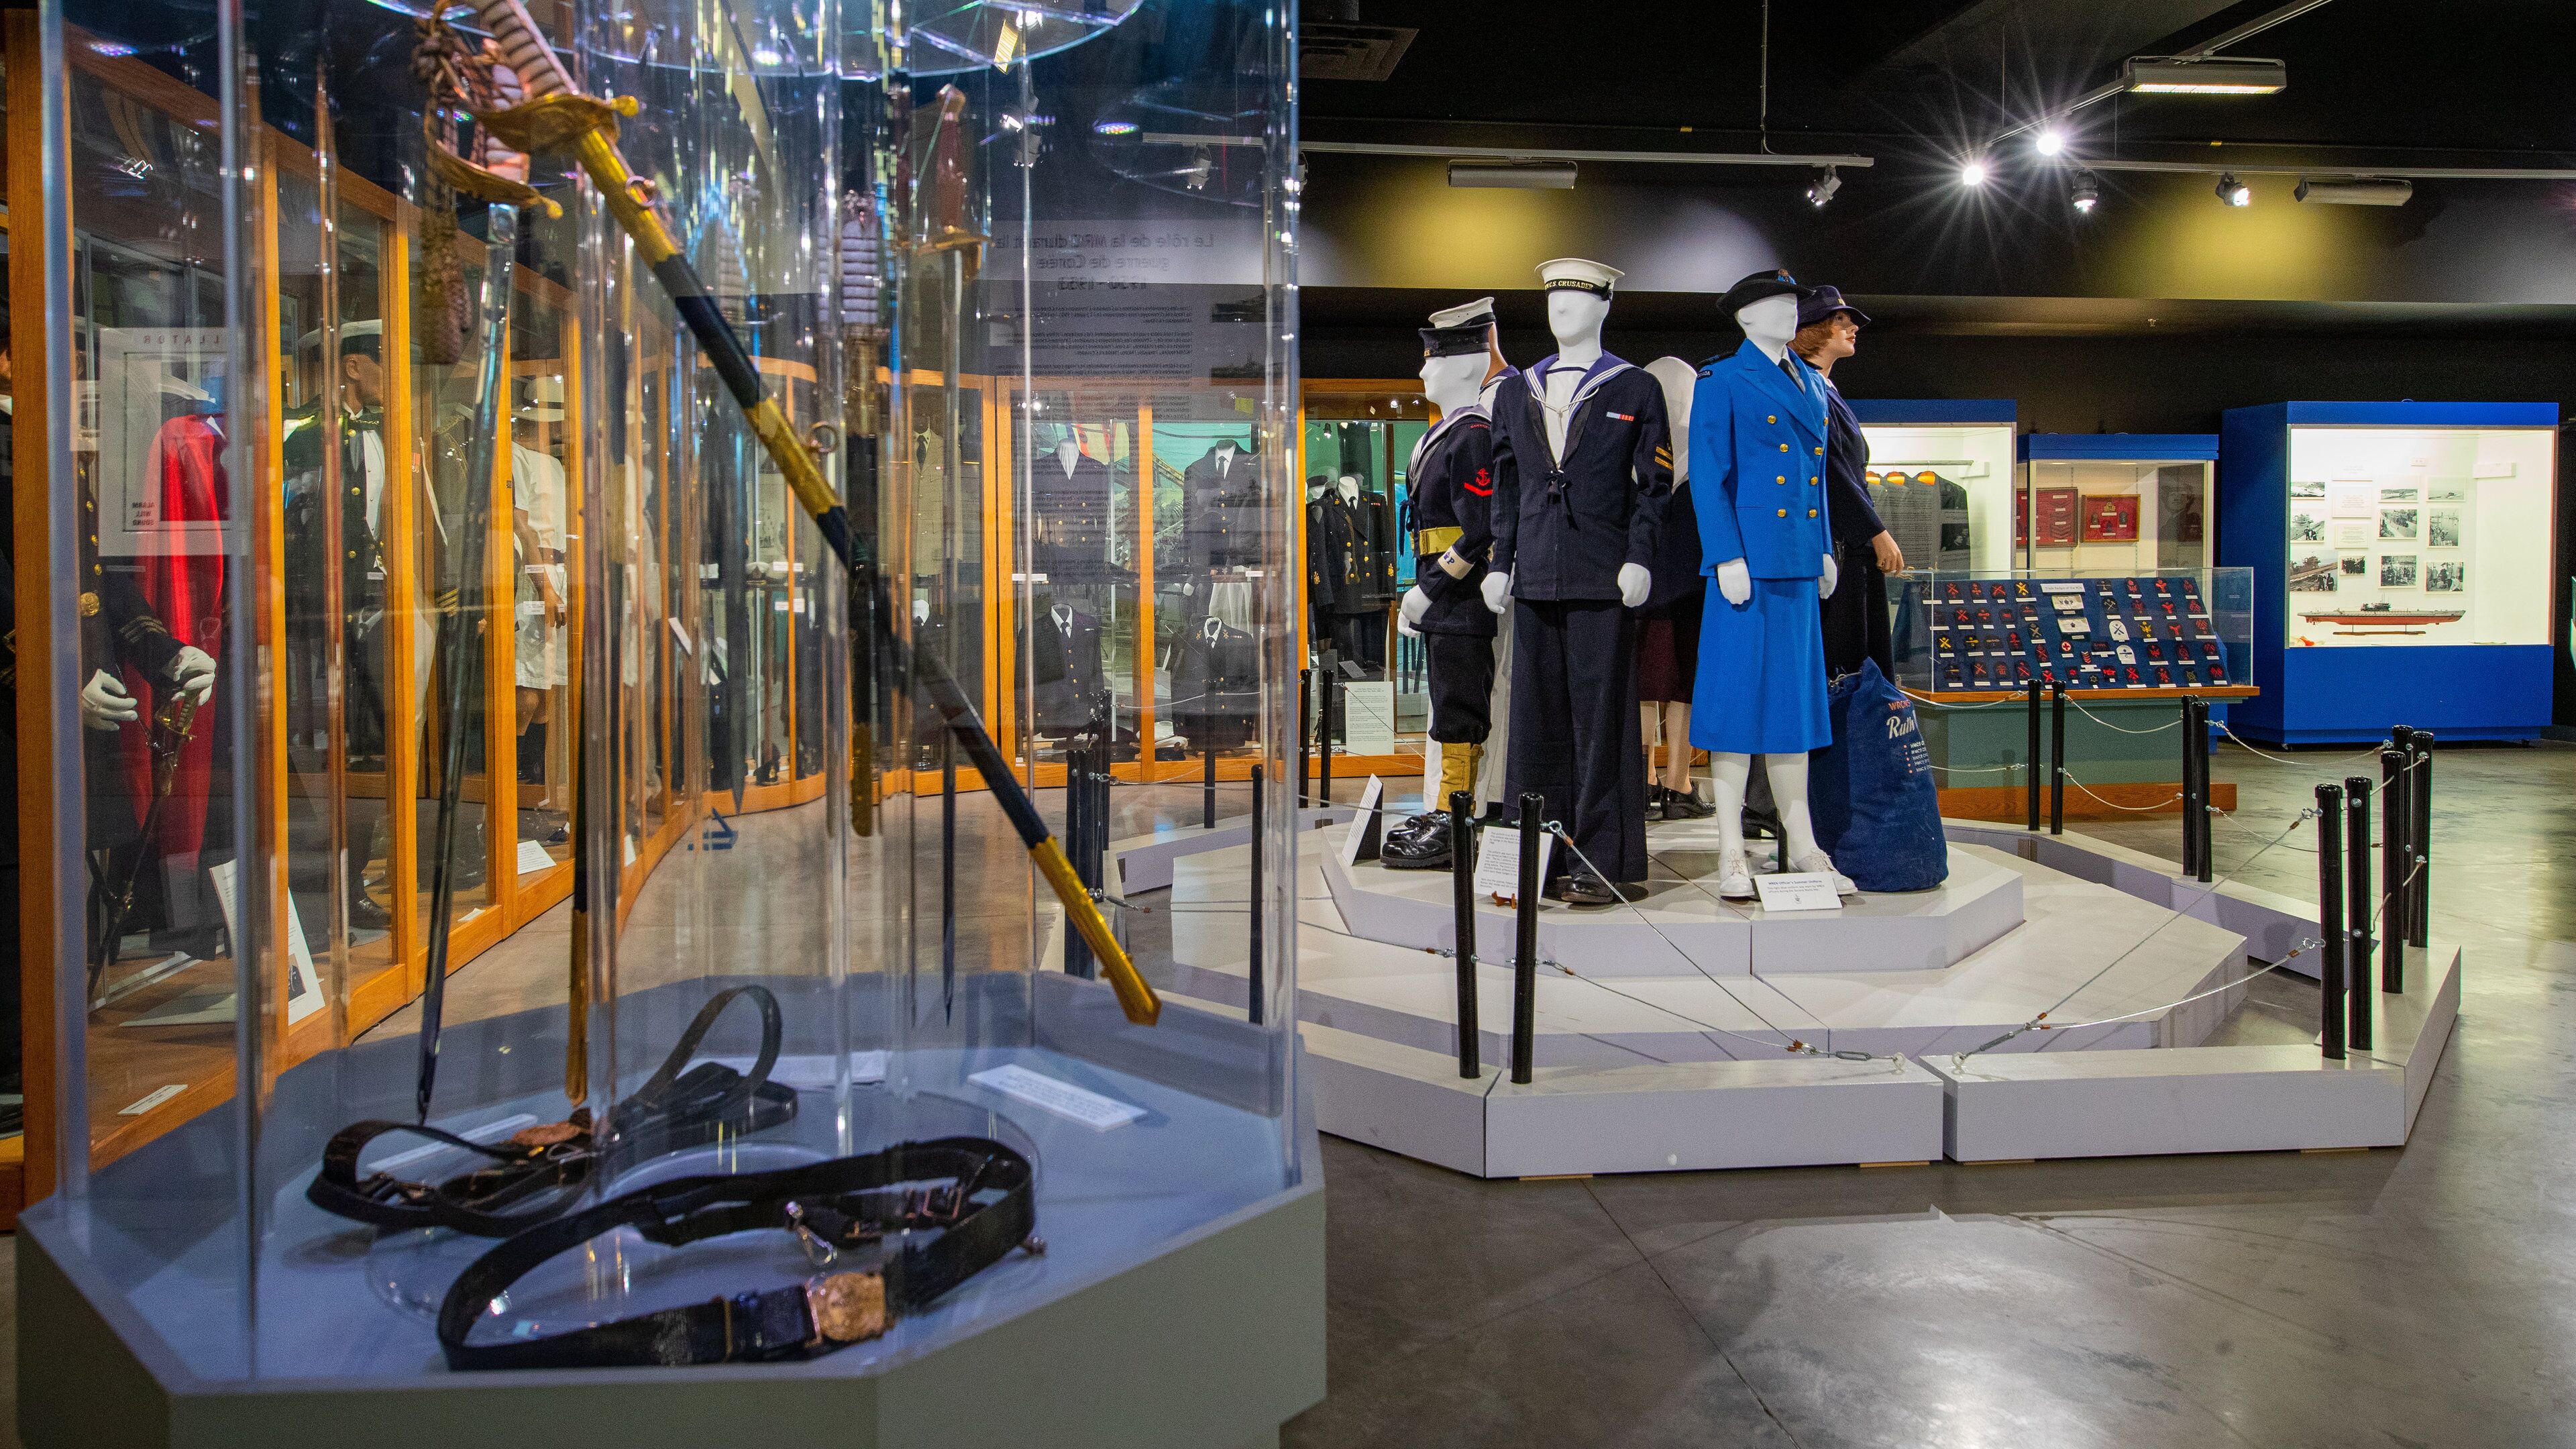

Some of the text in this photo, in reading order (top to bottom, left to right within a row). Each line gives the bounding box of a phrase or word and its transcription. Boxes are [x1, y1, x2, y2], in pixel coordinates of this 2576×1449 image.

[1558, 280, 1594, 290] CRUSADER
[1446, 557, 1456, 566] P
[1886, 716, 1915, 739] Ruth
